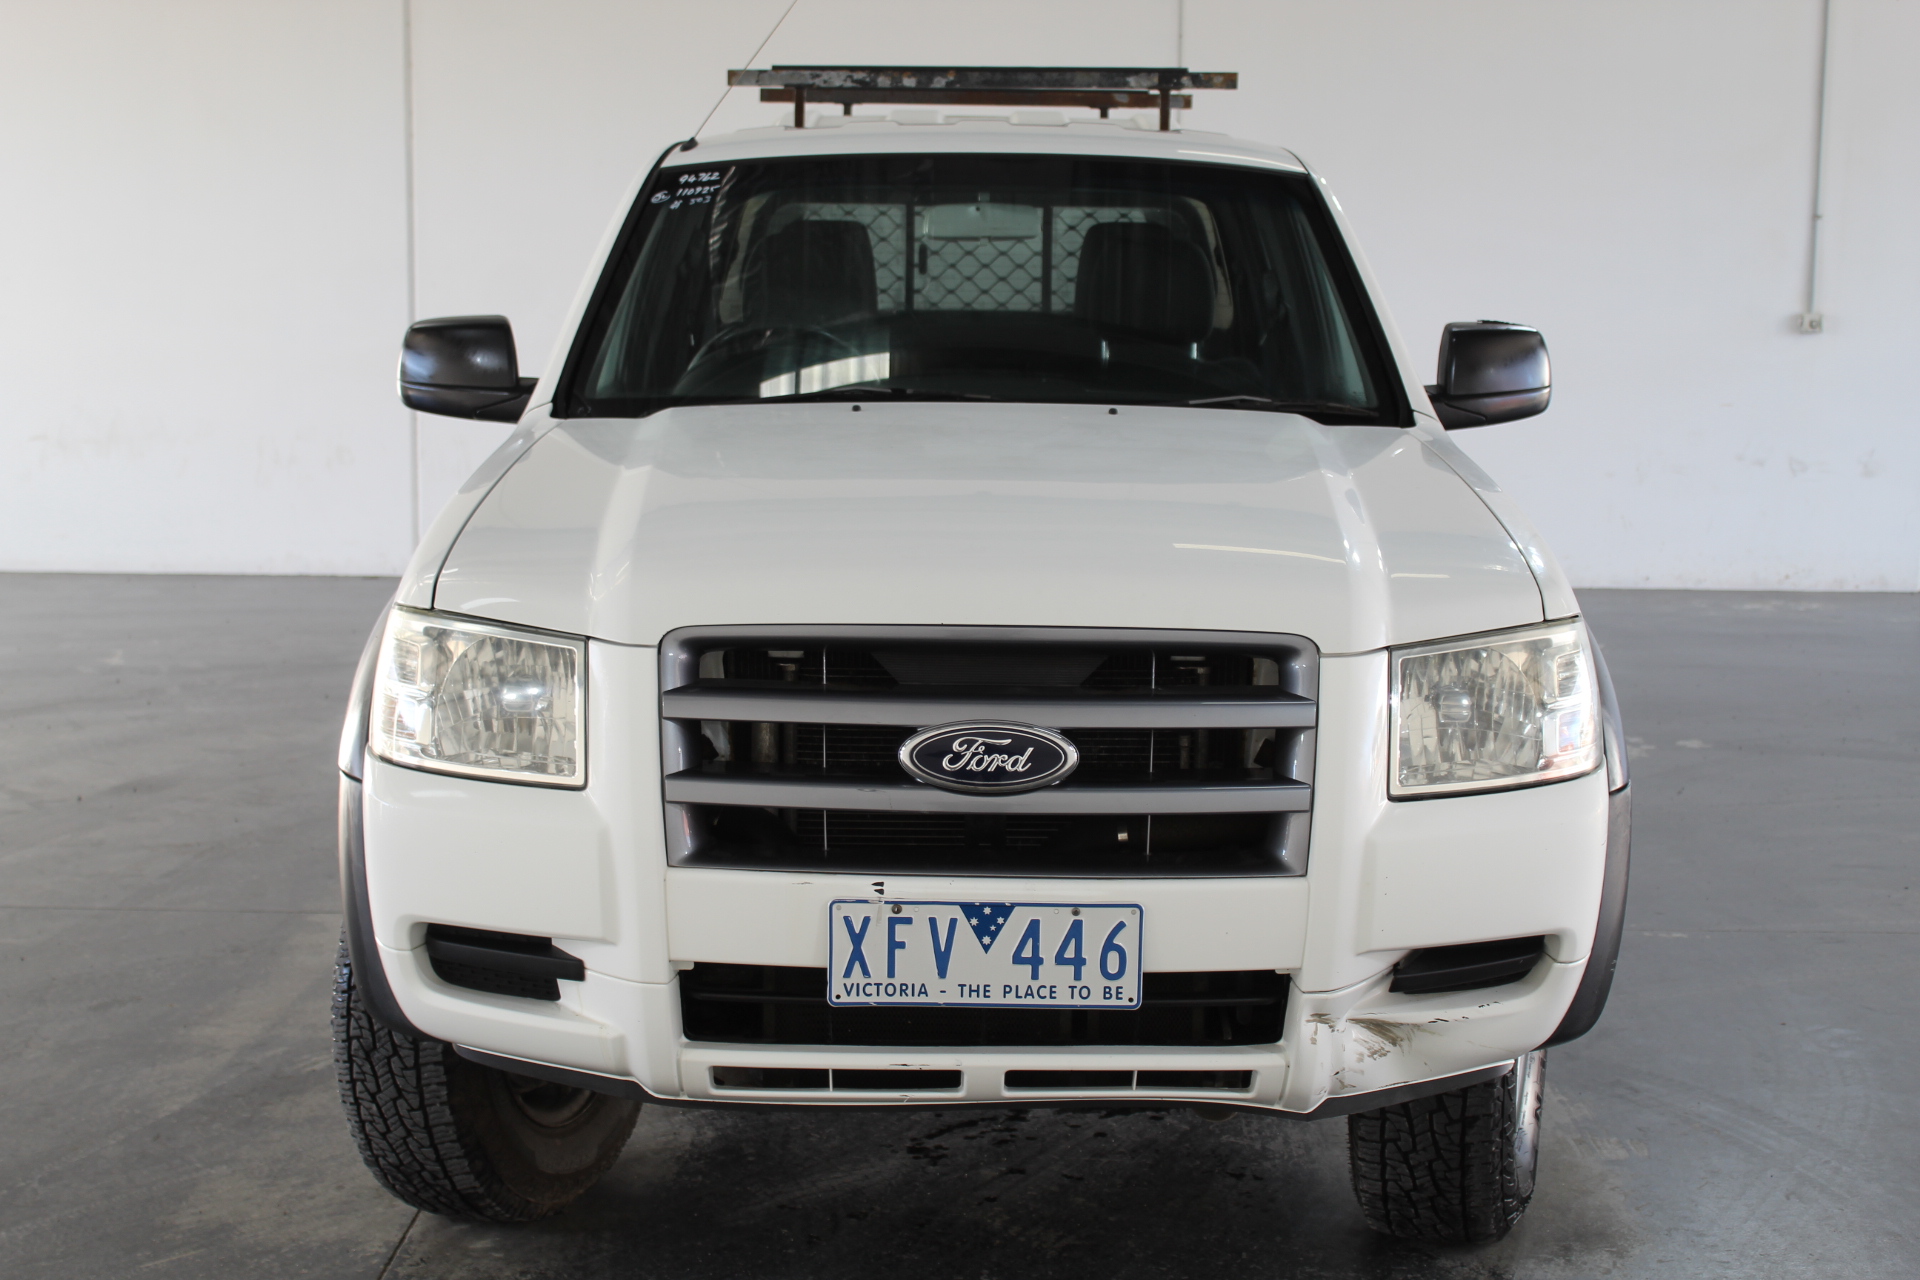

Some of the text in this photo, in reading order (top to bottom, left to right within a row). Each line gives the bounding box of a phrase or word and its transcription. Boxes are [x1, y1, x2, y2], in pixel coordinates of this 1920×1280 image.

[942, 736, 1034, 772] Ford
[843, 916, 1127, 982] XFV 446
[843, 983, 929, 998] VICTORIA
[958, 984, 991, 999] THE
[1003, 985, 1057, 1000] PLACE
[1069, 986, 1091, 1000] TO
[1103, 986, 1124, 1001] BE
